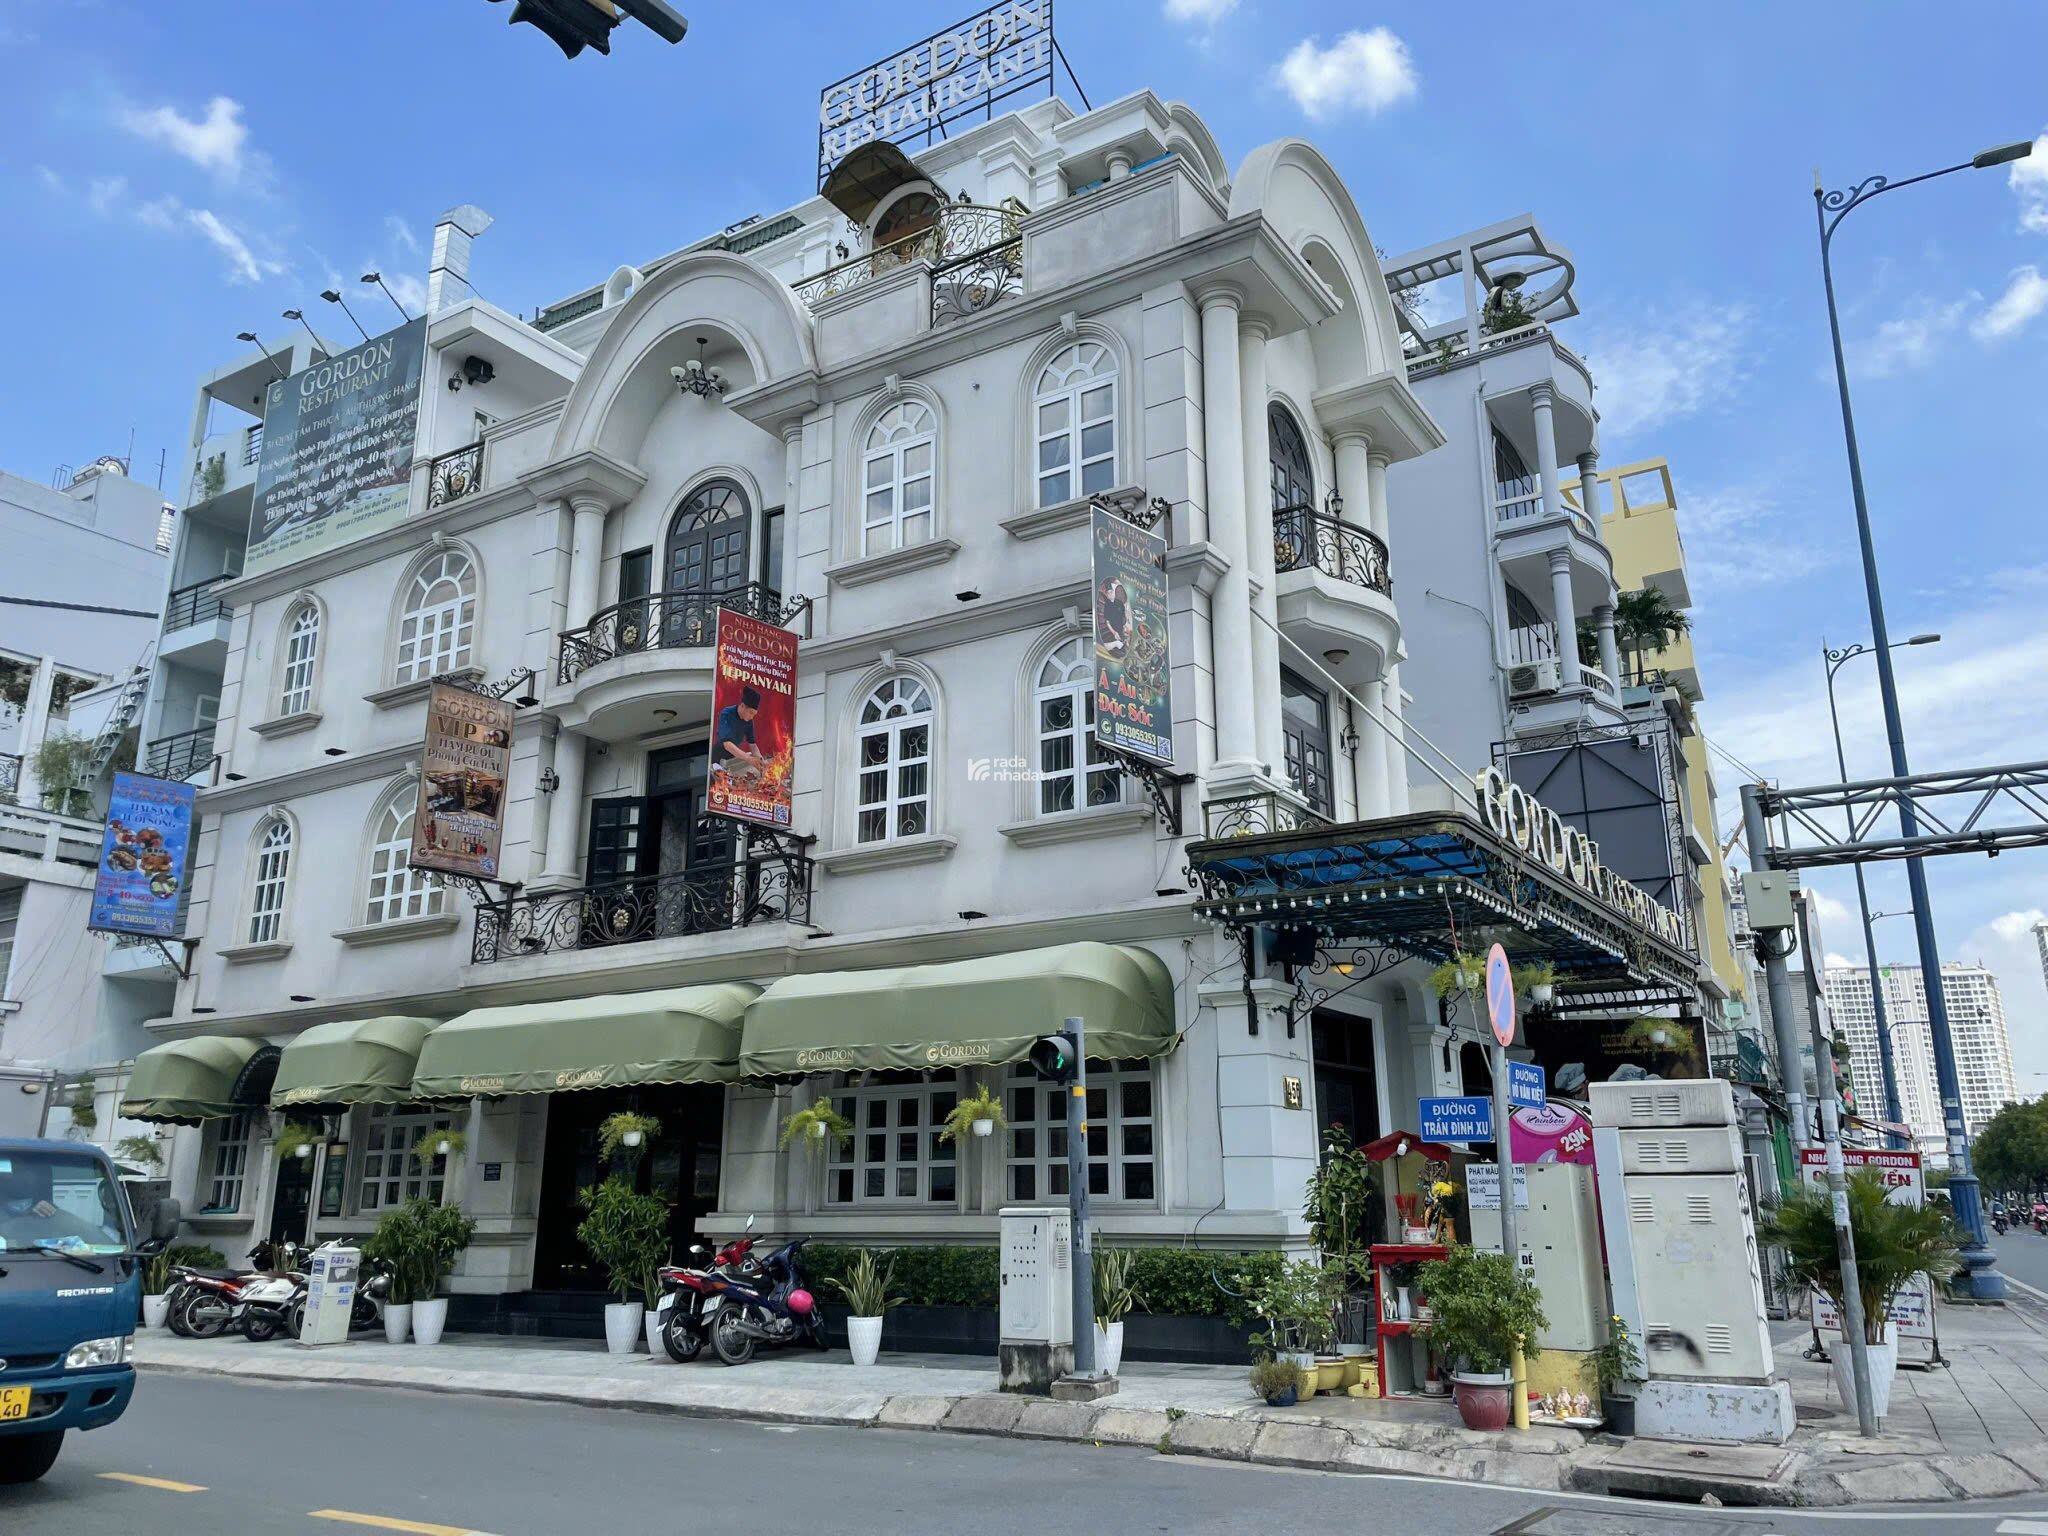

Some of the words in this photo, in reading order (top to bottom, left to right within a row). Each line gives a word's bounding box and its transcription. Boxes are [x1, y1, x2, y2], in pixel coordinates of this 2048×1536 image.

[819, 0, 1046, 128] GORDON
[821, 34, 1051, 164] RESTAURANT
[300, 338, 394, 396] GORDON
[298, 362, 391, 416] RESTAURANT
[330, 464, 345, 479] VIP
[1096, 526, 1163, 570] GORDON
[721, 624, 794, 660] GORDON
[722, 664, 792, 696] TEPPANYAKI
[434, 698, 510, 728] GORDON
[437, 716, 477, 739] VIP
[1115, 721, 1157, 745] 0933055353
[427, 747, 460, 766] Phong
[728, 793, 774, 812] 0933055353
[1476, 765, 1604, 898] GORDON
[1599, 865, 1688, 950] RESTAURANT
[808, 1049, 855, 1061] GORDON
[940, 1043, 990, 1057] GORDON
[470, 1077, 504, 1088] GORDON
[565, 1070, 603, 1083] GORDON
[1531, 1086, 1543, 1105] KIỆT
[1432, 1102, 1476, 1116] ĐƯỜNG
[1526, 1114, 1567, 1124] Rainbow
[1424, 1116, 1449, 1135] TRẦN
[1450, 1117, 1474, 1135] ĐÌNH
[1476, 1121, 1489, 1135] XU
[1560, 1126, 1591, 1153] 29K
[1868, 1155, 1913, 1167] GORDON
[57, 1287, 114, 1297] FRONTIER
